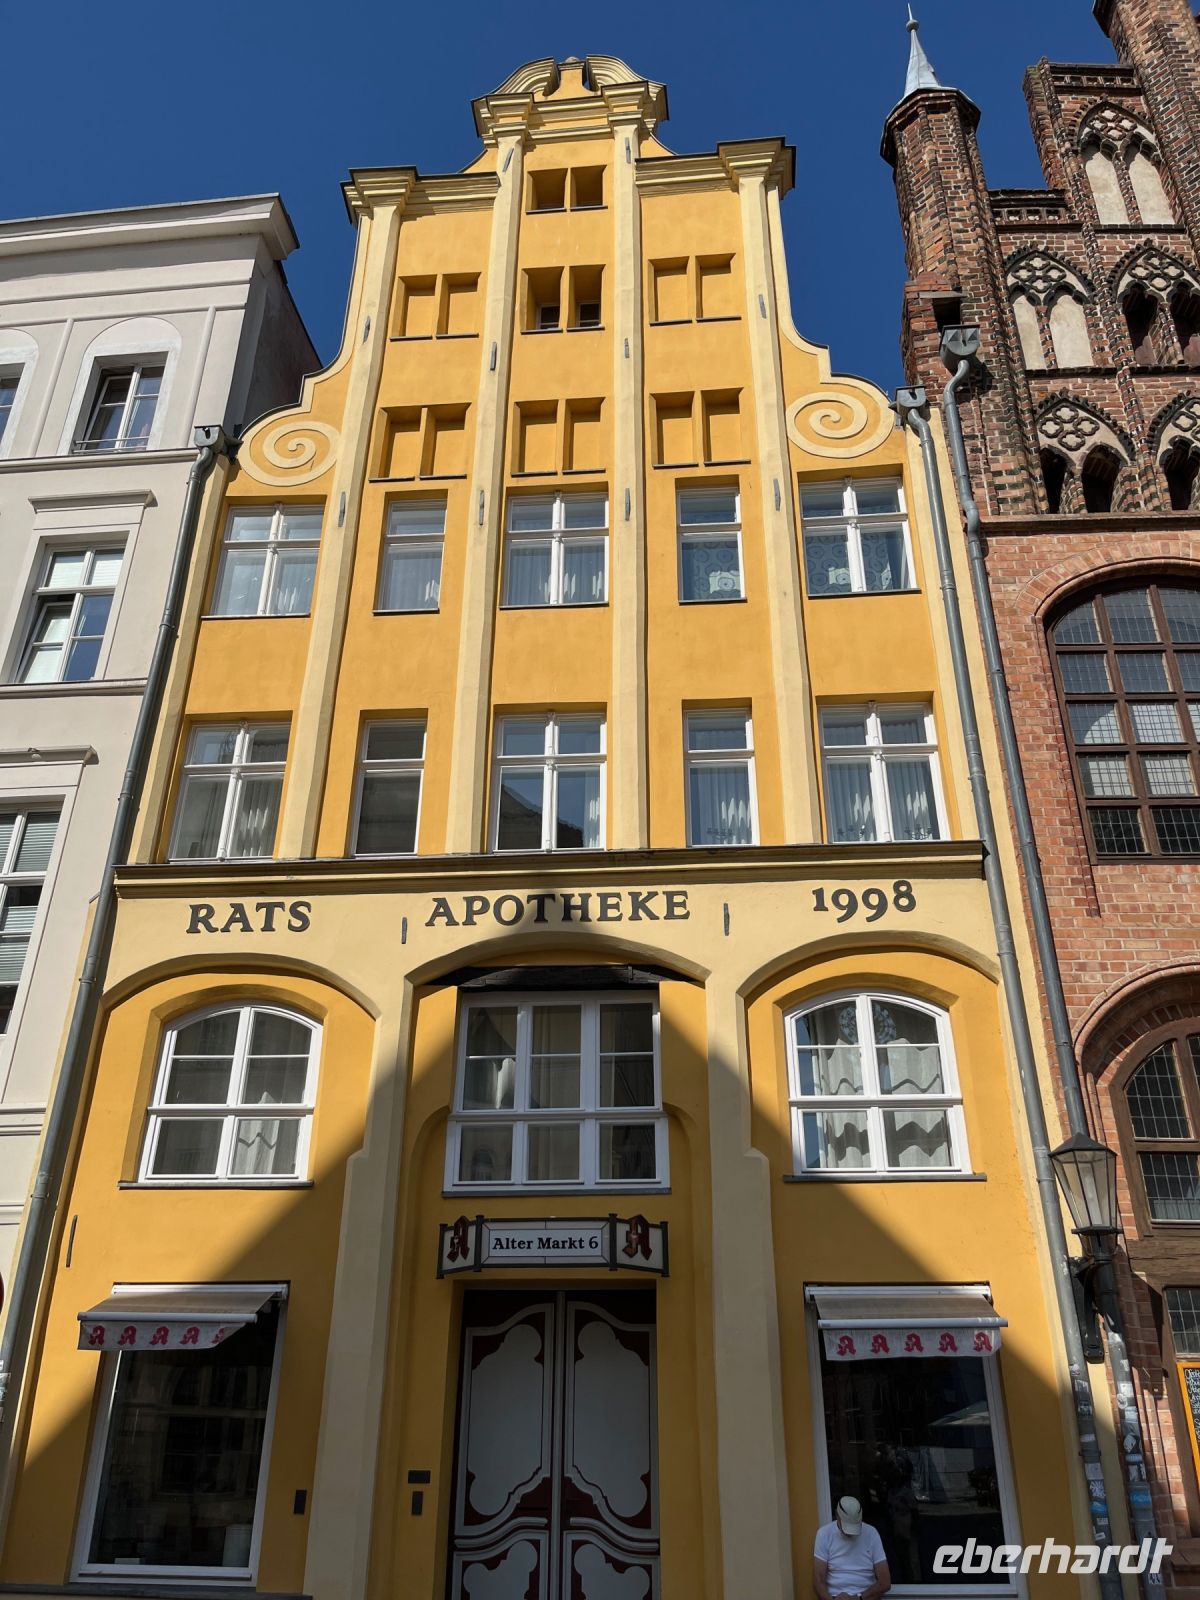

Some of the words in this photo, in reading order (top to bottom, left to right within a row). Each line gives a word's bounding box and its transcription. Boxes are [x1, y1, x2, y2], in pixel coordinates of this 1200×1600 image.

[186, 900, 312, 934] RATS
[425, 890, 691, 927] APOTHEKE
[812, 880, 916, 923] 1998
[492, 1237, 533, 1251] Alter
[537, 1237, 585, 1250] Markt
[589, 1235, 599, 1250] 6
